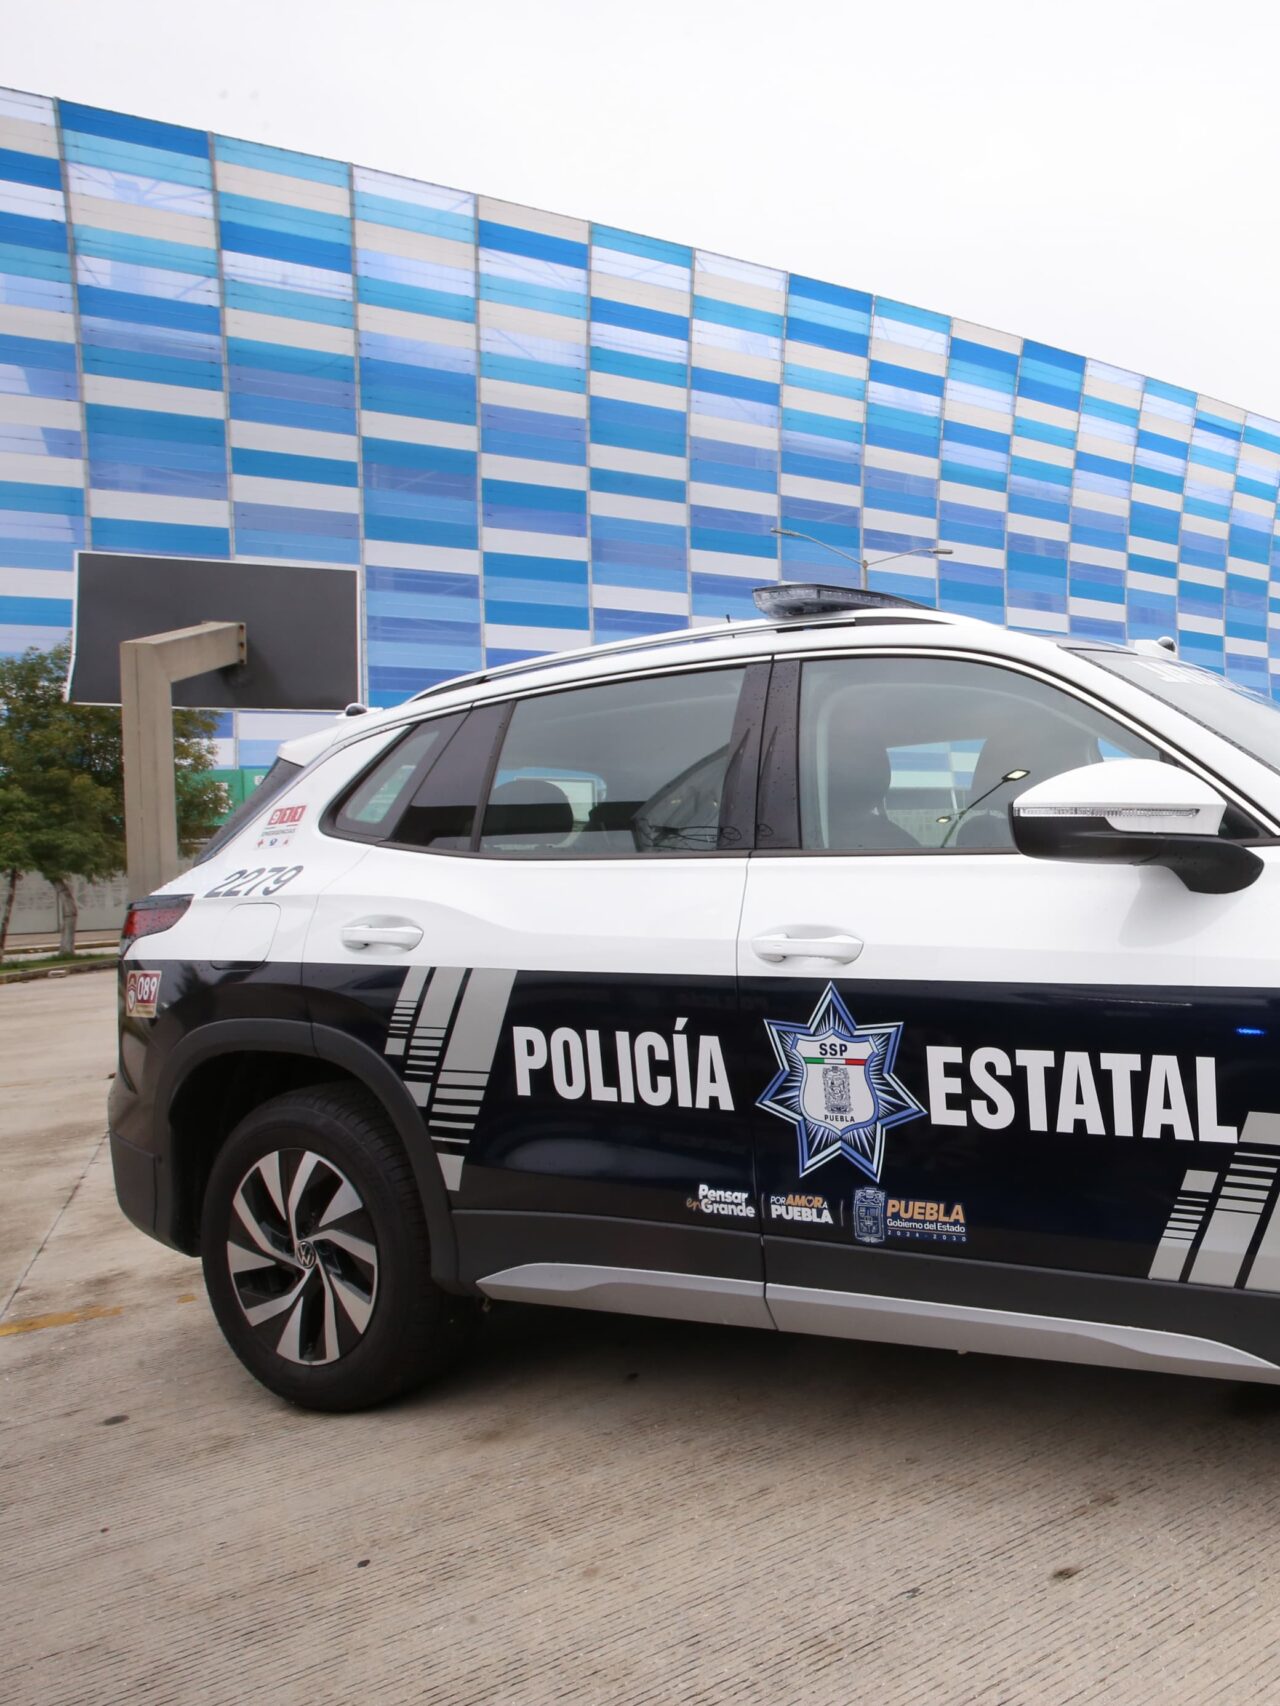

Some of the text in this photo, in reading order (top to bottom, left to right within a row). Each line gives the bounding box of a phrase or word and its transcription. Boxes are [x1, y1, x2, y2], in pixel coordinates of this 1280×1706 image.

[269, 806, 305, 824] 911
[203, 865, 304, 898] 2279
[137, 976, 158, 1001] 089
[819, 1043, 848, 1057] SSP
[512, 1017, 1238, 1144] POLICÍA ESTATAL
[824, 1114, 855, 1123] PUEBLA
[698, 1184, 748, 1203] Pensar
[770, 1196, 786, 1204] POR
[785, 1194, 823, 1208] AMOR
[701, 1198, 756, 1217] Grande
[771, 1204, 834, 1224] PUEBLA
[886, 1199, 965, 1223] PUEBLA
[886, 1218, 966, 1233] Gobierno del Estado
